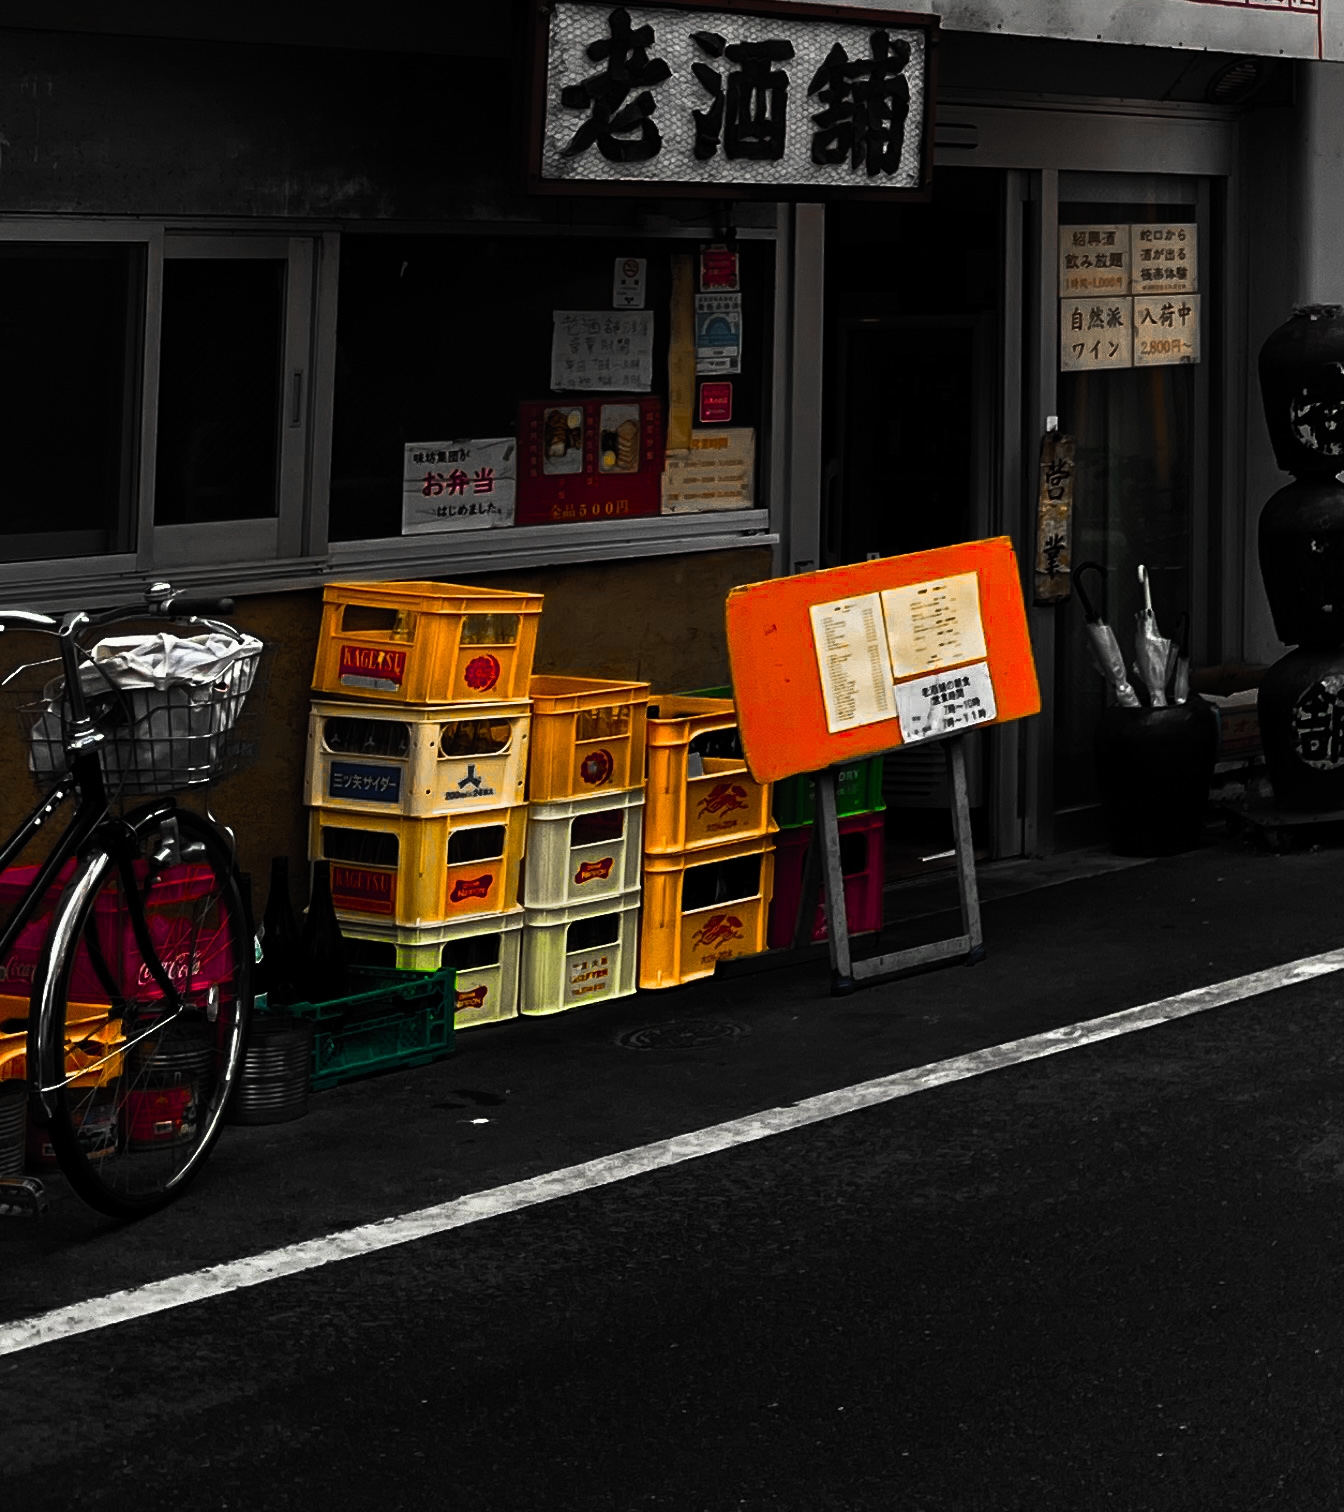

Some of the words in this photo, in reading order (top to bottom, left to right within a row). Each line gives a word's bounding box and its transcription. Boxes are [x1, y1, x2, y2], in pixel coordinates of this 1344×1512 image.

[1065, 252, 1124, 269] 飲み放題
[1071, 306, 1124, 331] 自然派
[1140, 301, 1192, 328] 入荷中
[1071, 339, 1120, 360] ワイン
[421, 467, 494, 497] お弁当
[333, 772, 398, 793] 三ツ矢サイダー
[334, 868, 391, 893] KAGETSU
